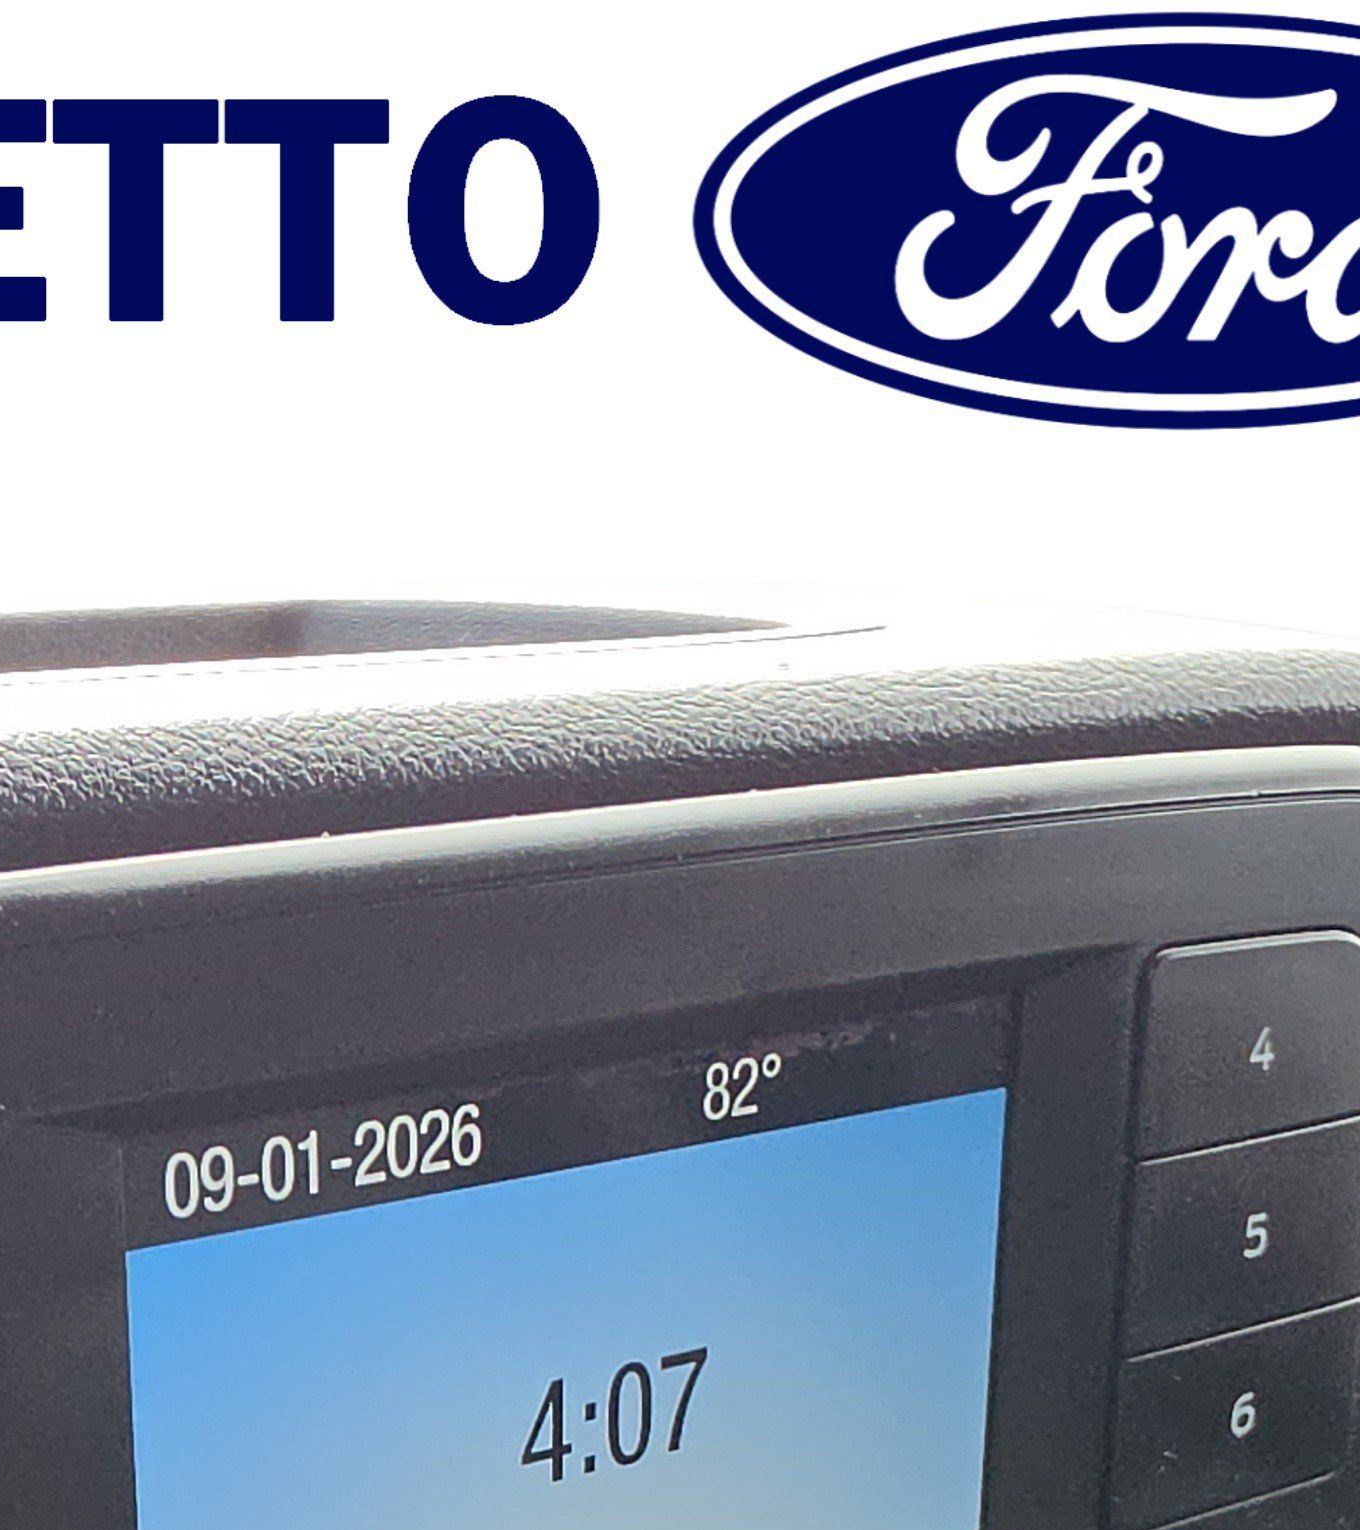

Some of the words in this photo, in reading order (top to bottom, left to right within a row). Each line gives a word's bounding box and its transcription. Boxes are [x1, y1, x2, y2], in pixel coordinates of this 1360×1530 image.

[1248, 1026, 1274, 1071] 4
[163, 1103, 482, 1219] 09-01-2026
[1242, 1213, 1268, 1259] 5
[520, 1346, 709, 1483] 4:07
[1229, 1391, 1256, 1438] 6
